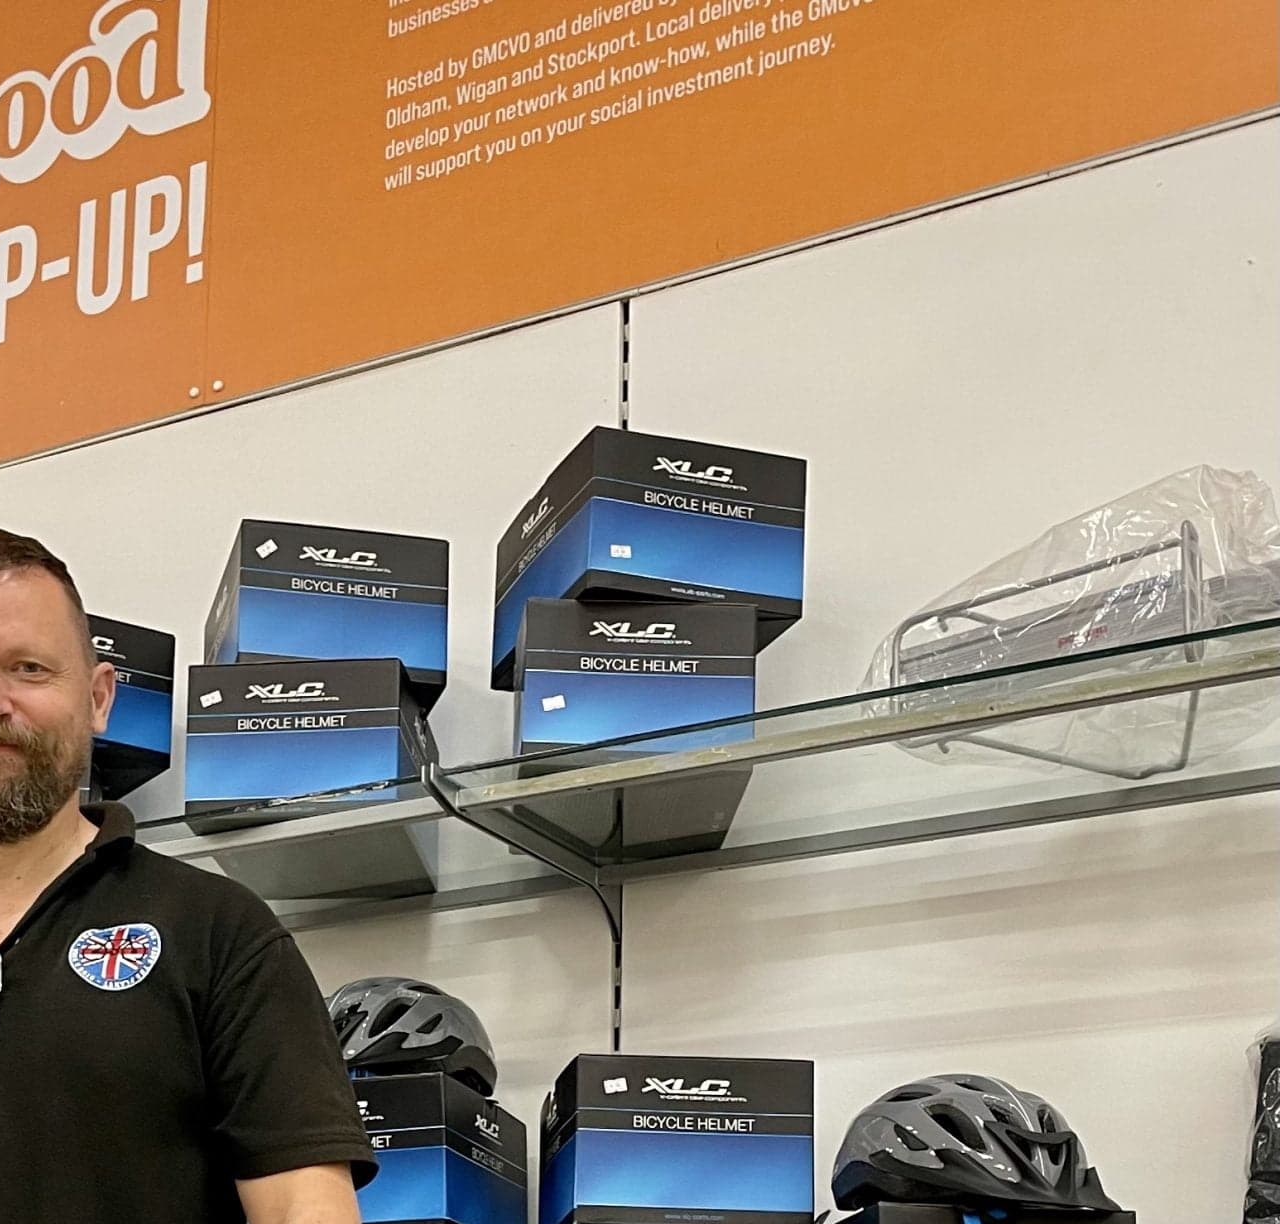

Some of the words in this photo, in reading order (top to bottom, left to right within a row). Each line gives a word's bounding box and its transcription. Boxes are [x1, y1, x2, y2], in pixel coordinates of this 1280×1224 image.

[388, 0, 479, 38] businesses
[386, 61, 444, 98] Hosted
[448, 58, 467, 79] by
[472, 32, 530, 70] GMCVO
[534, 19, 567, 49] and
[571, 0, 654, 35] delivered
[386, 95, 452, 129] Oldham,
[456, 75, 507, 106] Wigan
[511, 58, 544, 87] and
[546, 28, 641, 75] Stockport.
[646, 8, 694, 42] Local
[384, 126, 450, 160] develop
[453, 112, 491, 142] your
[495, 84, 568, 124] network
[572, 70, 605, 99] and
[610, 40, 710, 87] know-how,
[715, 20, 766, 52] while
[771, 9, 803, 34] the
[384, 165, 412, 191] will
[416, 144, 481, 180] support
[485, 136, 516, 163] you
[520, 127, 542, 147] on
[546, 113, 586, 144] your
[590, 90, 642, 126] social
[647, 56, 754, 107] investment
[758, 33, 836, 76] journey.
[652, 457, 733, 482] XLC
[644, 491, 699, 511] BICYCLE
[702, 500, 755, 519] HELMET
[299, 546, 377, 566] XLC
[291, 577, 345, 594] BICYCLE
[348, 584, 399, 599] HELMET
[589, 621, 676, 638] XLC
[580, 657, 640, 671] BICYCLE
[643, 660, 700, 672] HELMET
[245, 682, 324, 699] XLC
[237, 717, 292, 730] BICYCLE
[295, 715, 347, 728] HELMET
[641, 1077, 731, 1096] XLC
[633, 1115, 694, 1130] BICYCLE
[697, 1117, 756, 1132] HELMET
